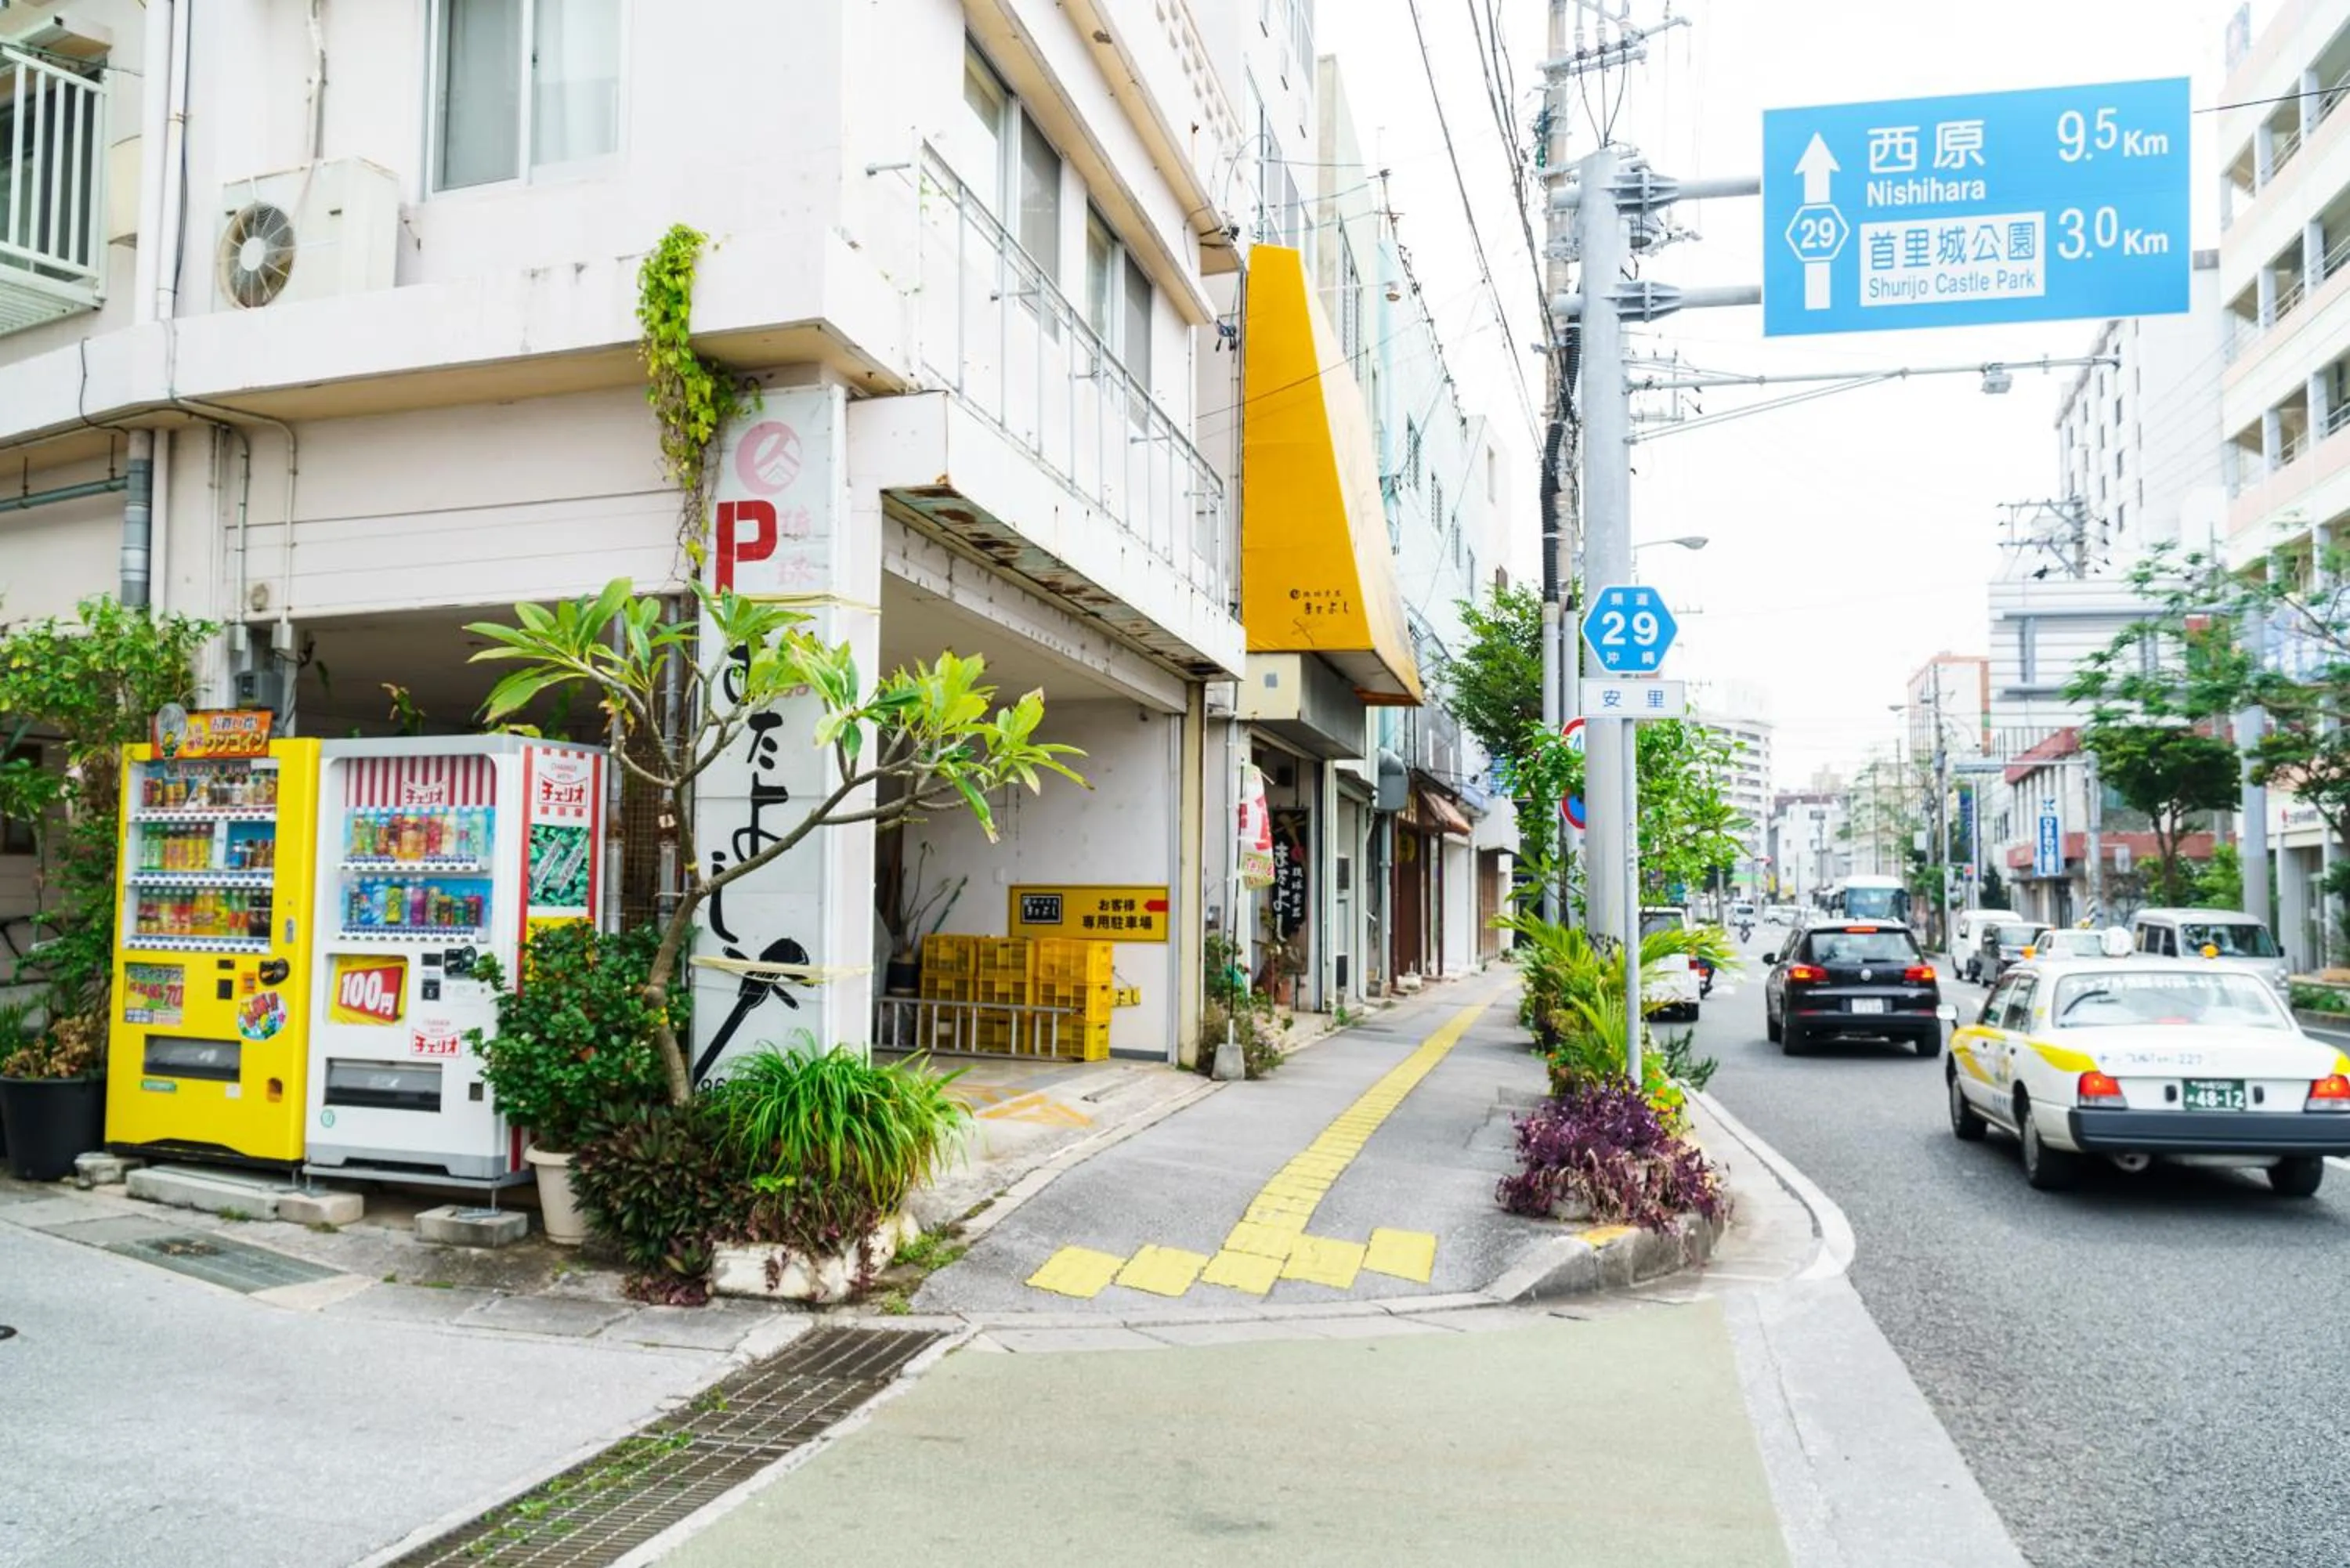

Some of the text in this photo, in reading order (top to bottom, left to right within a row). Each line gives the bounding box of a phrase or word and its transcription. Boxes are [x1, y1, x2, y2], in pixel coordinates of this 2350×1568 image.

[1867, 120, 1986, 174] 西原
[2057, 108, 2168, 162] 9.5 Km
[1867, 178, 1986, 208] Nishihara
[1800, 220, 1835, 249] 29
[1868, 222, 2037, 271] 首里城公園
[2058, 206, 2168, 259] 3.0 Km
[1868, 270, 2036, 301] Shurijo Castle Park
[715, 499, 778, 597] P
[1602, 610, 1659, 646] 29
[1603, 689, 1665, 707] 安里
[207, 730, 269, 753] ワンコイン
[406, 787, 443, 804] チェリオ
[541, 779, 584, 803] チェリオ
[1098, 898, 1136, 912] お客様
[1082, 915, 1153, 930] 専用駐車場
[341, 970, 396, 1016] 100円
[414, 1035, 458, 1053] チェリオ
